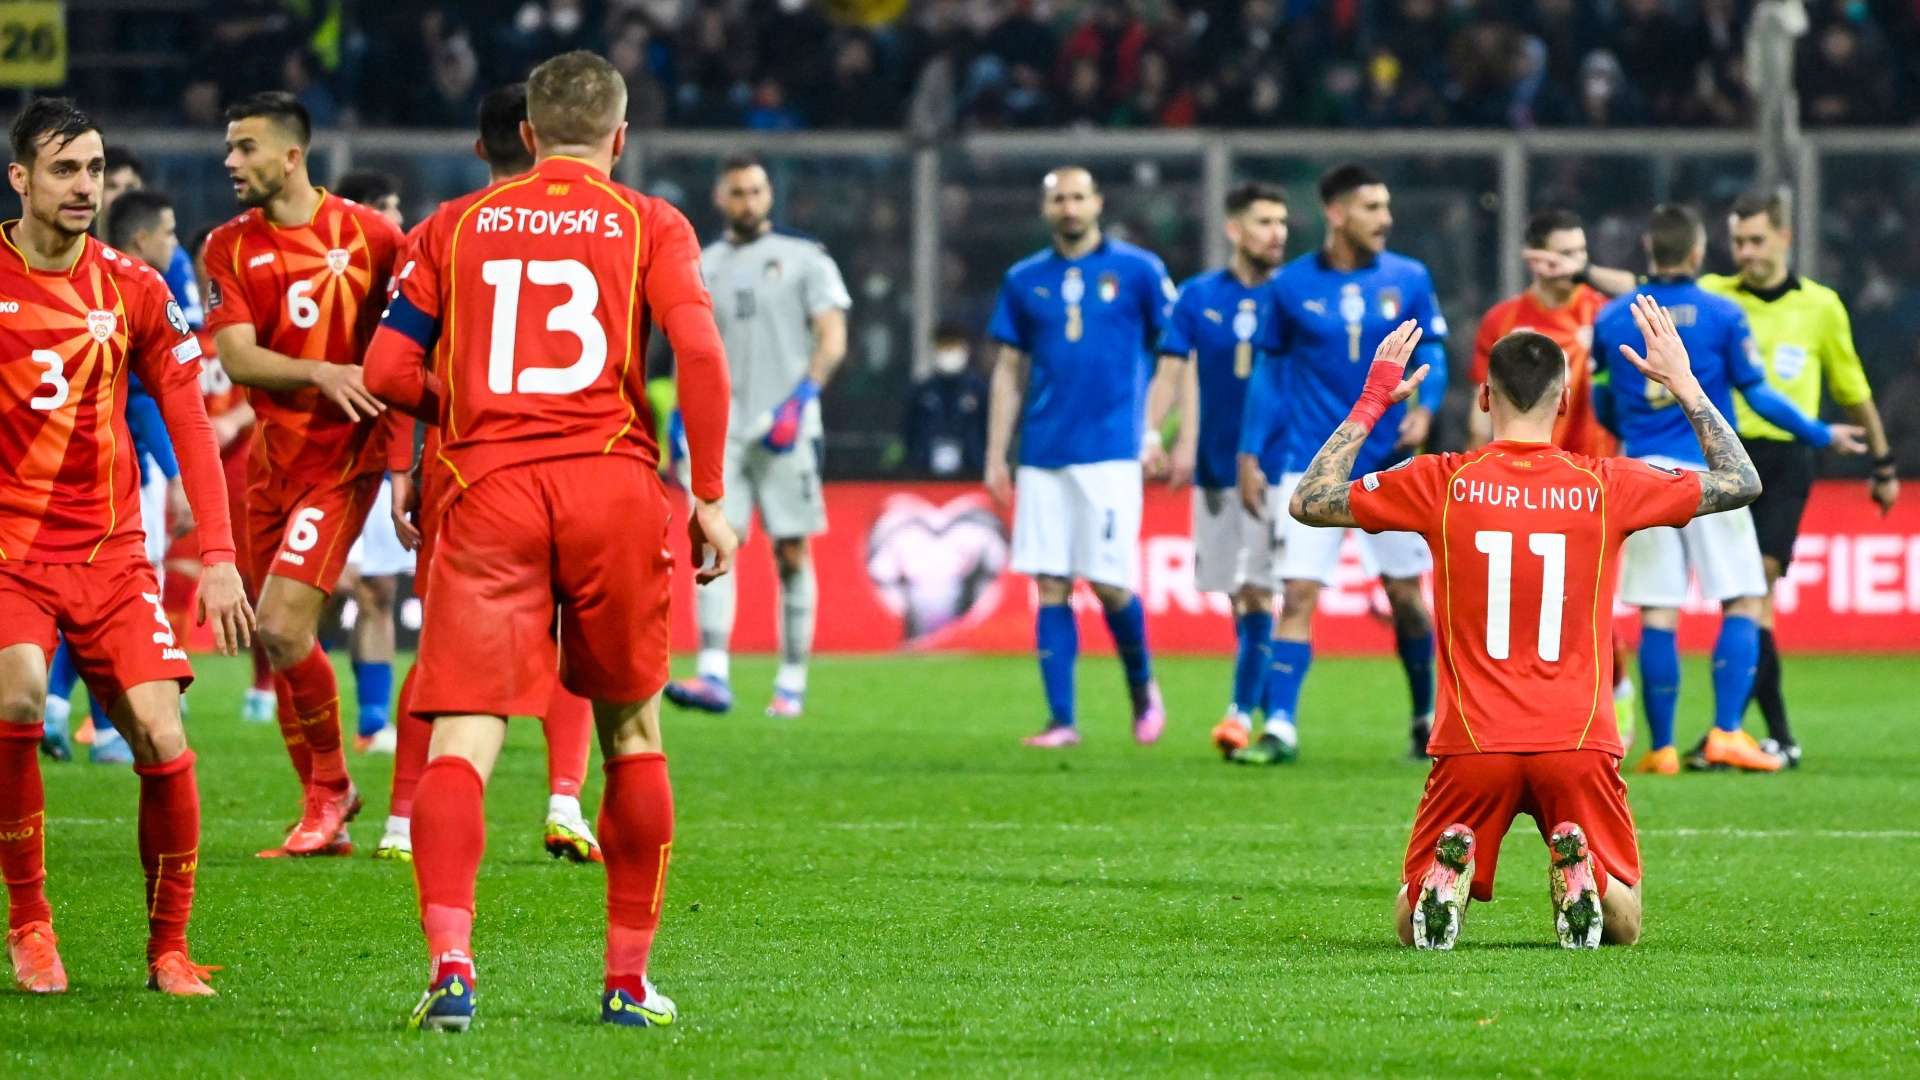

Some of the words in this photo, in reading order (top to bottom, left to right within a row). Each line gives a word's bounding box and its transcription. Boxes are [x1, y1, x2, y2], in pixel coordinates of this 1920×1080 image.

[476, 206, 599, 236] RISTOVSKI
[603, 213, 623, 238] S.
[287, 280, 320, 329] 6
[482, 258, 608, 395] 13
[30, 349, 69, 410] 3
[1453, 477, 1599, 513] CHURLINOV
[288, 507, 325, 551] 6
[1474, 530, 1566, 662] 11
